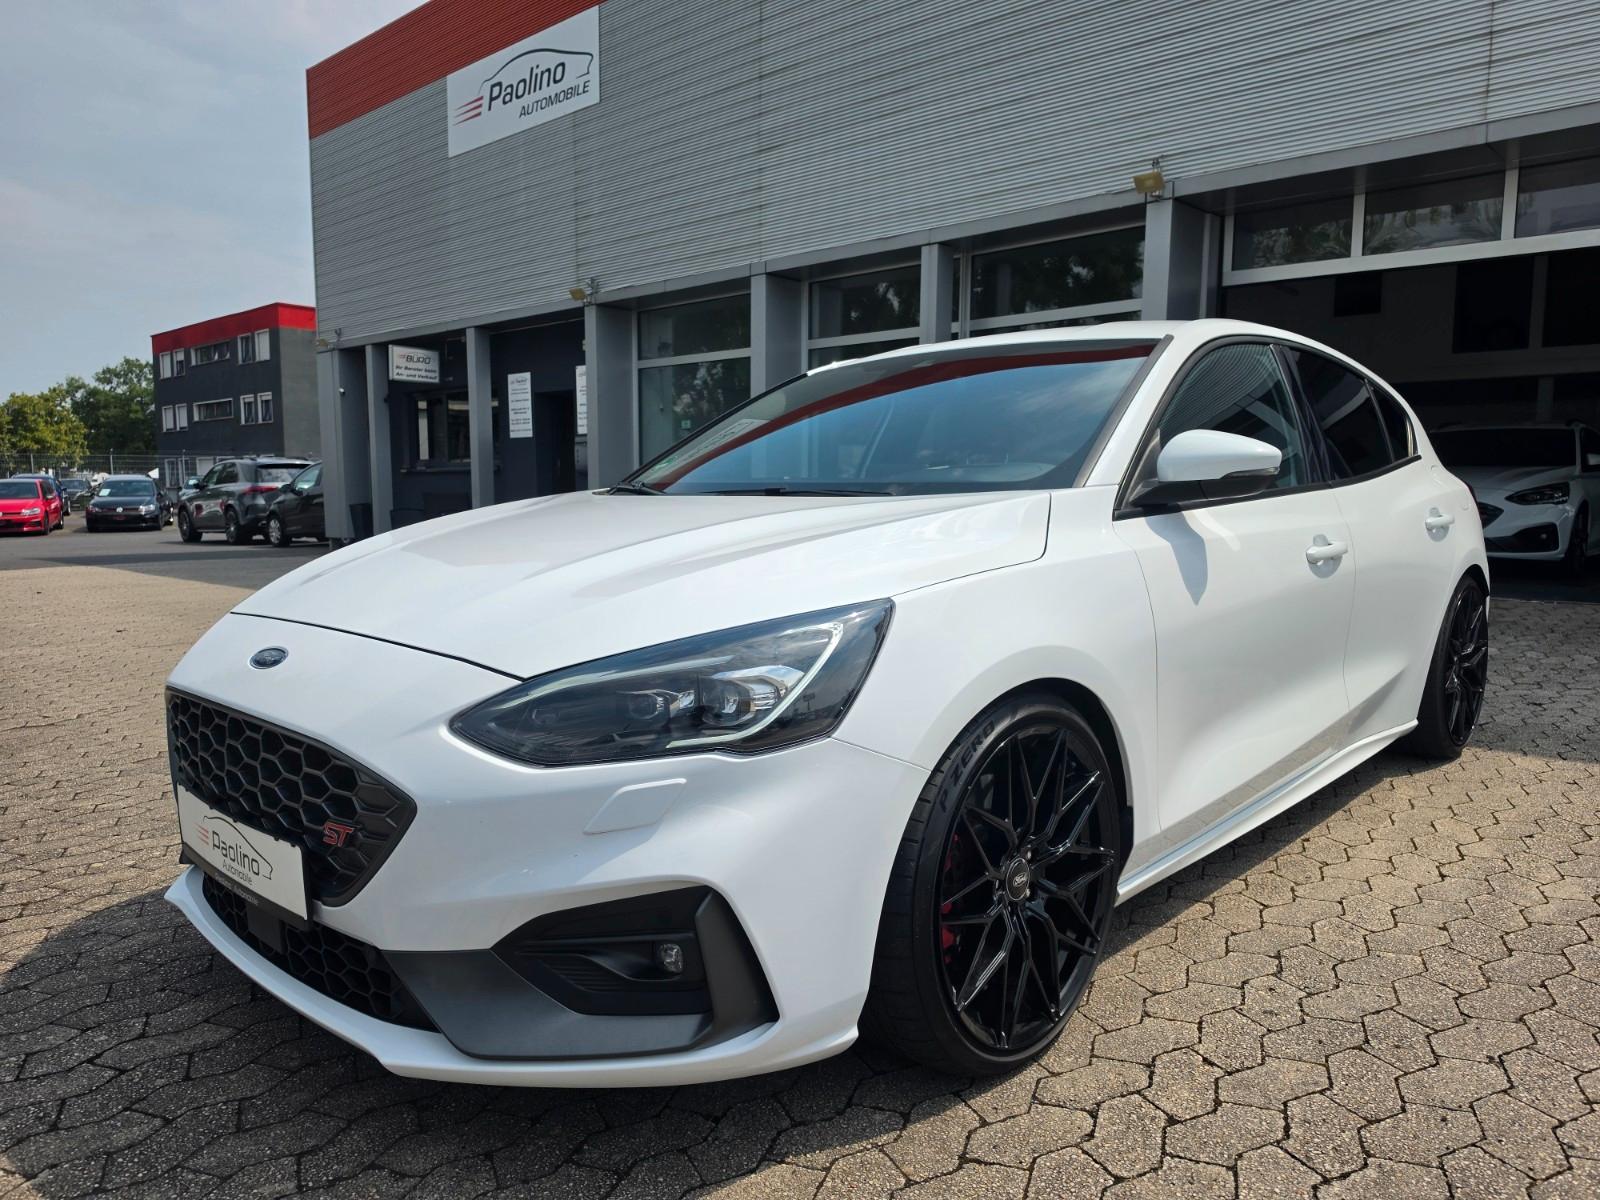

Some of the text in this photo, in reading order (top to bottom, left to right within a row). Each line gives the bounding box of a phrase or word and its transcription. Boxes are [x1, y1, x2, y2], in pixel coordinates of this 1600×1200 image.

[488, 62, 566, 112] Paolino
[519, 80, 590, 118] AUTOMOBILE
[950, 720, 995, 787] ZERO
[212, 830, 260, 876] Paolino
[323, 821, 353, 847] ST
[223, 859, 253, 885] Automobile
